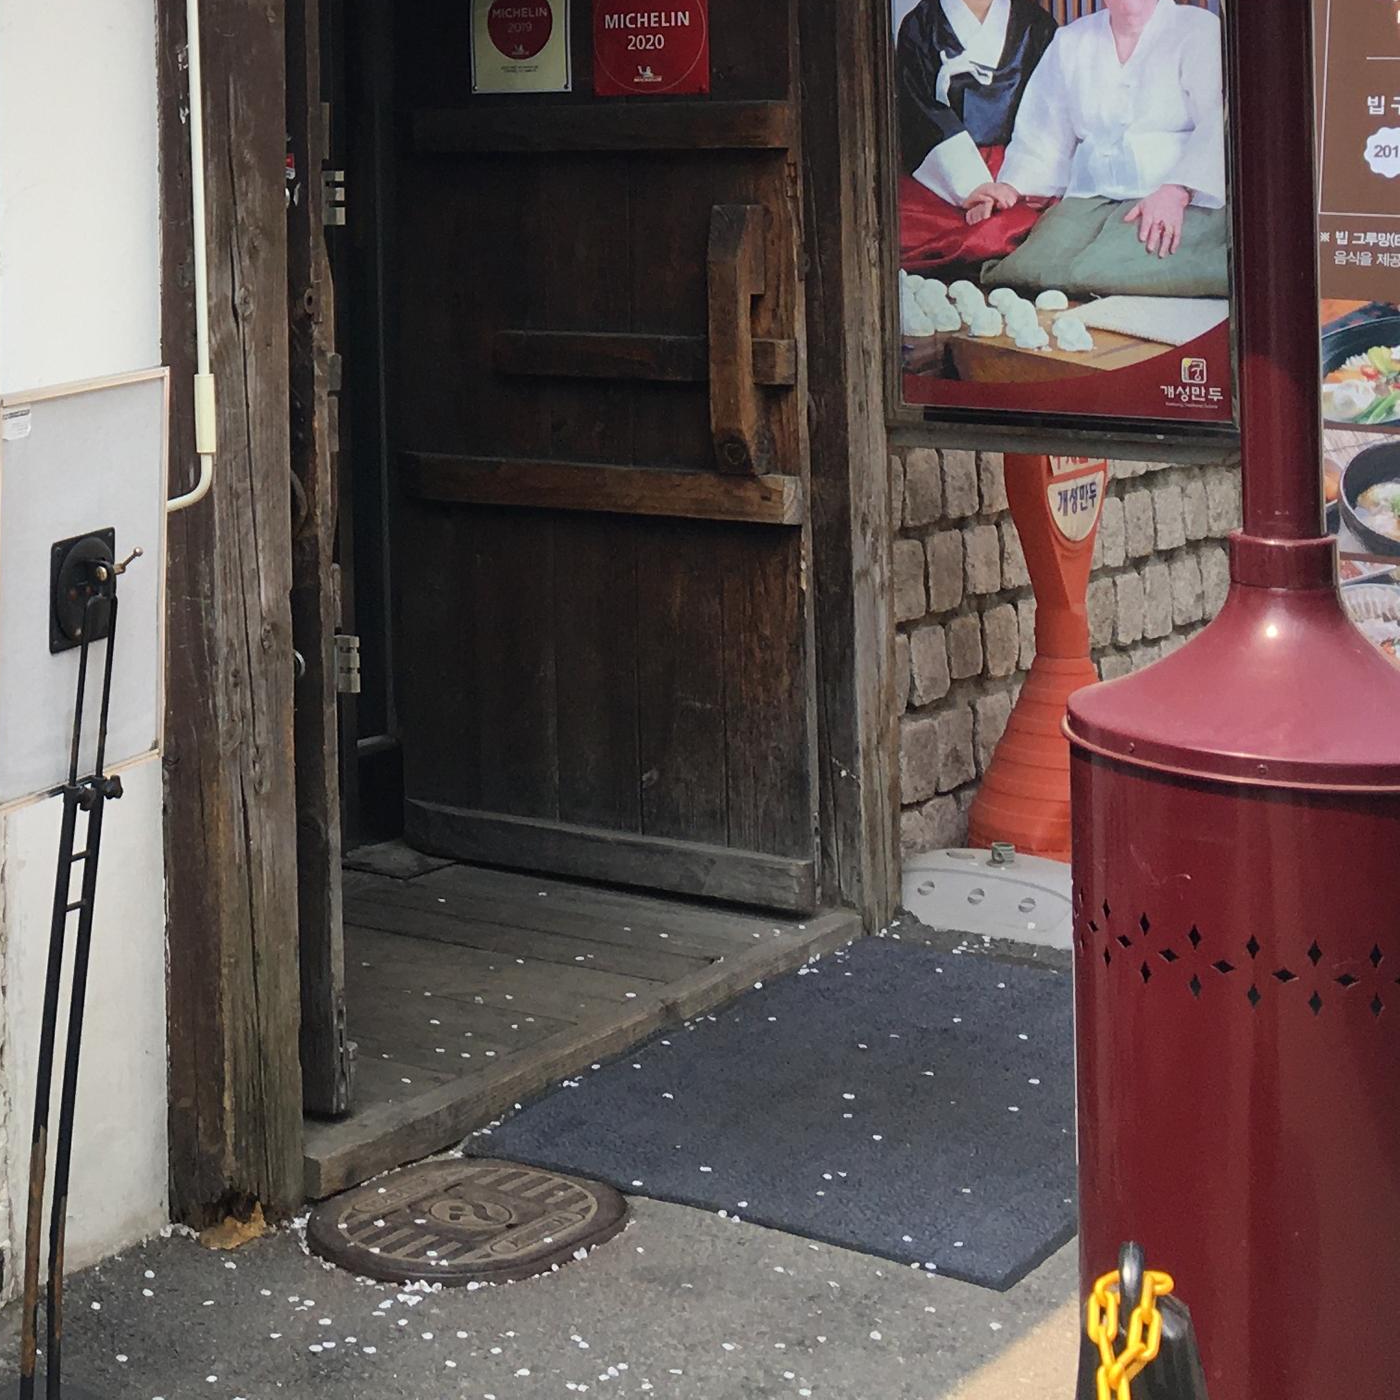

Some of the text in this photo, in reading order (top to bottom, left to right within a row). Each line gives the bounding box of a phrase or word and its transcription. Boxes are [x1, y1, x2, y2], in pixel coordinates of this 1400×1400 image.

[492, 6, 548, 19] MICHELIN
[604, 10, 690, 30] MICHELIN
[627, 34, 665, 51] 2020
[1333, 250, 1373, 266] 음식을
[1159, 385, 1224, 402] 개성만두
[1057, 480, 1097, 517] 개성만두
